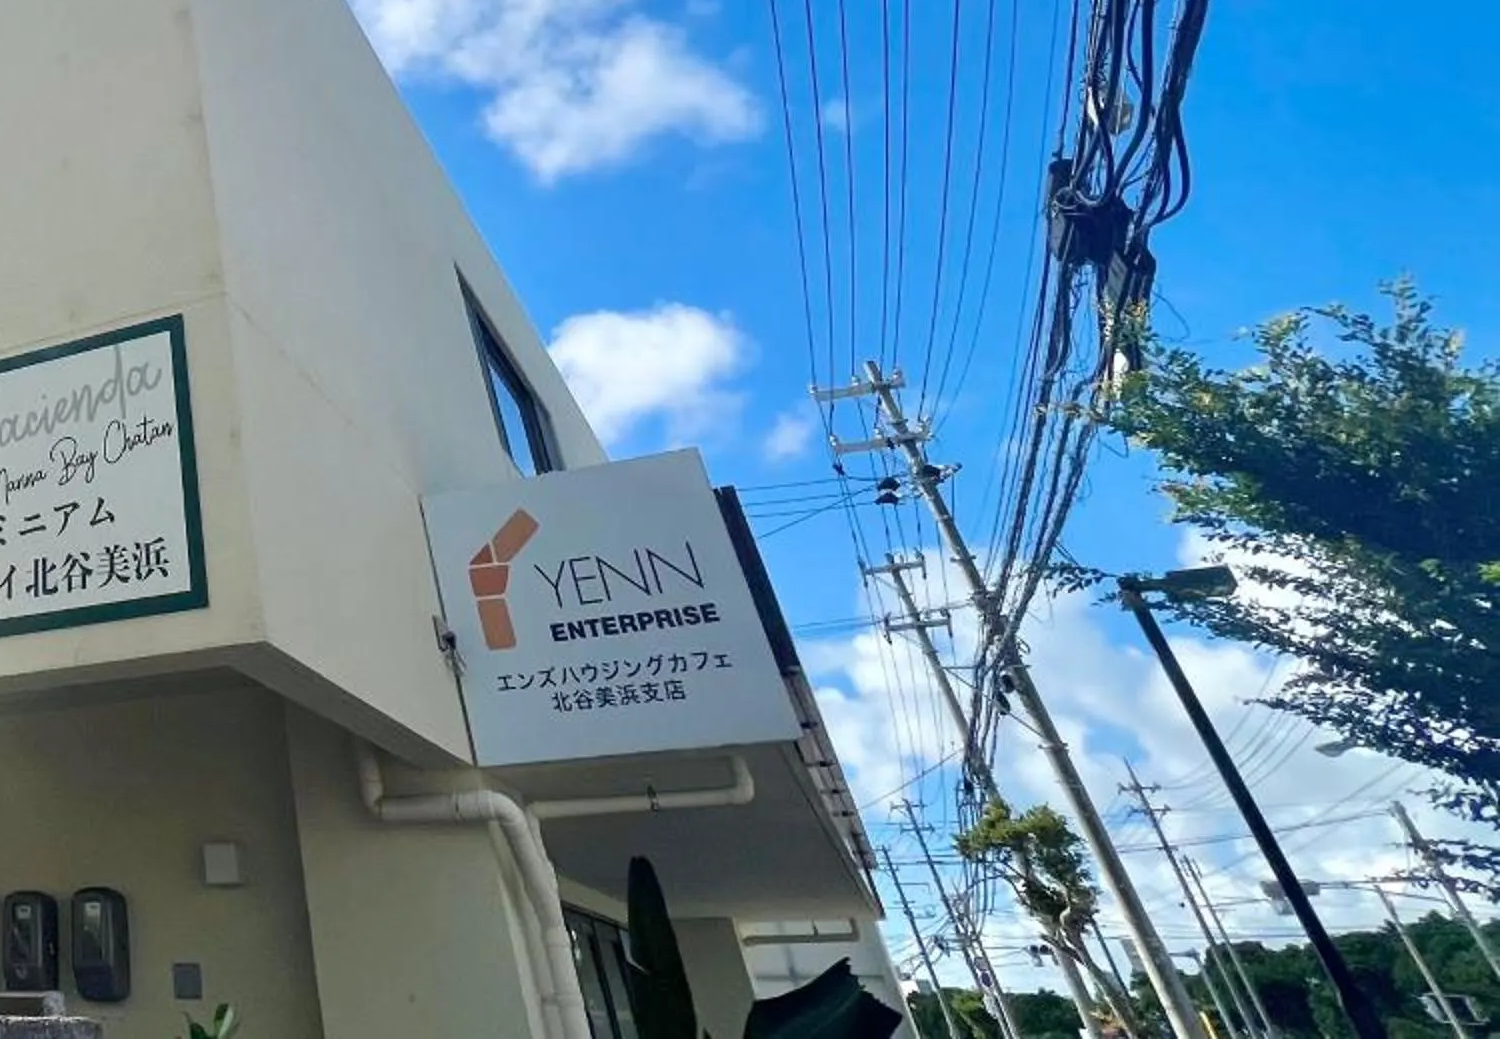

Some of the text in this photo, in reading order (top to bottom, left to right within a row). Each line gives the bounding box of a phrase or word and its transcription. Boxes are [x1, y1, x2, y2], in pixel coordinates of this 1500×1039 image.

[49, 436, 100, 486] Bay
[103, 414, 175, 464] Chatan
[533, 541, 705, 610] YENN
[550, 603, 721, 643] ENTERPRISE
[497, 651, 734, 693] エンズハウジングカフェ
[551, 680, 687, 713] 北谷美浜支店
